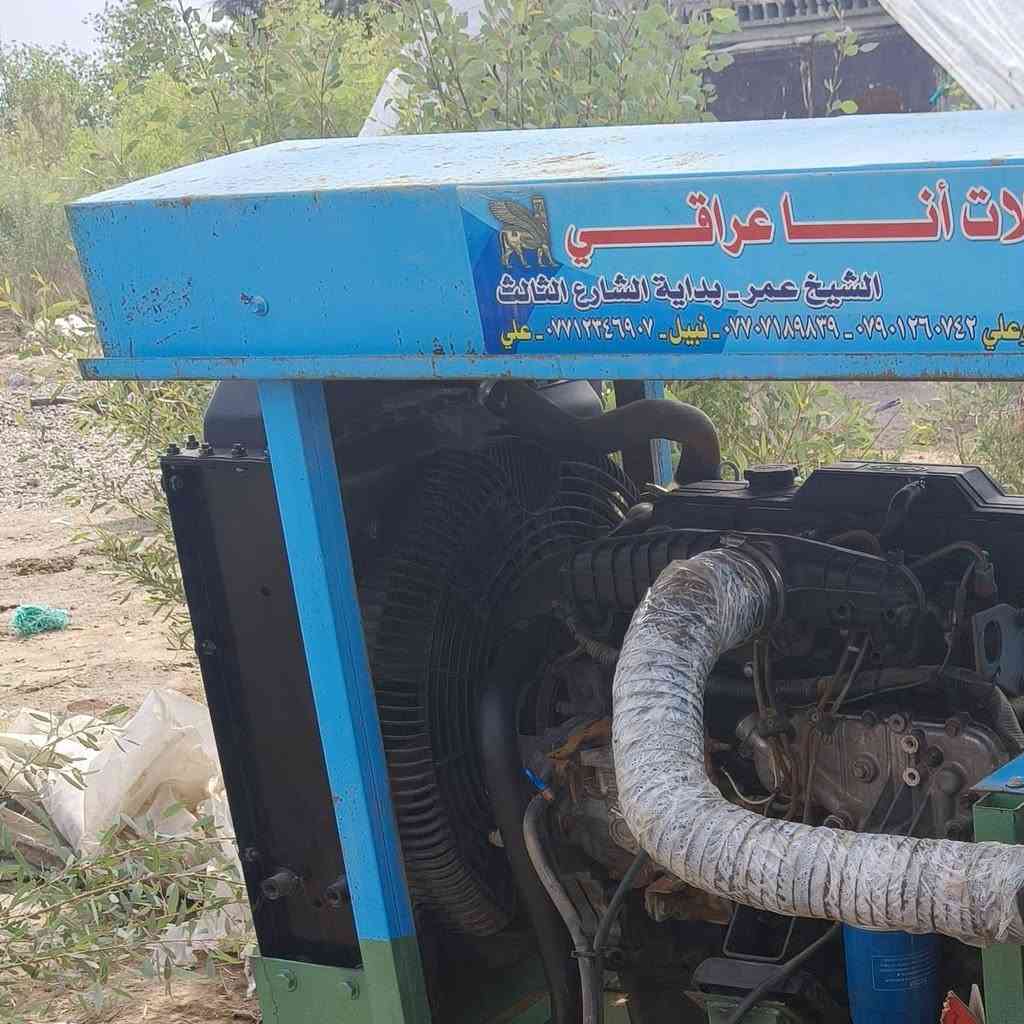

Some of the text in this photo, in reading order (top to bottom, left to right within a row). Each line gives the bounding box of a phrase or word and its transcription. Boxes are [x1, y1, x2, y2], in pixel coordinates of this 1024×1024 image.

[565, 191, 775, 267] عراقي
[497, 273, 568, 305] الثالث
[572, 272, 650, 310] الشارع
[652, 273, 724, 308] بداية
[804, 268, 883, 308] الشيخ
[501, 320, 532, 349] علي
